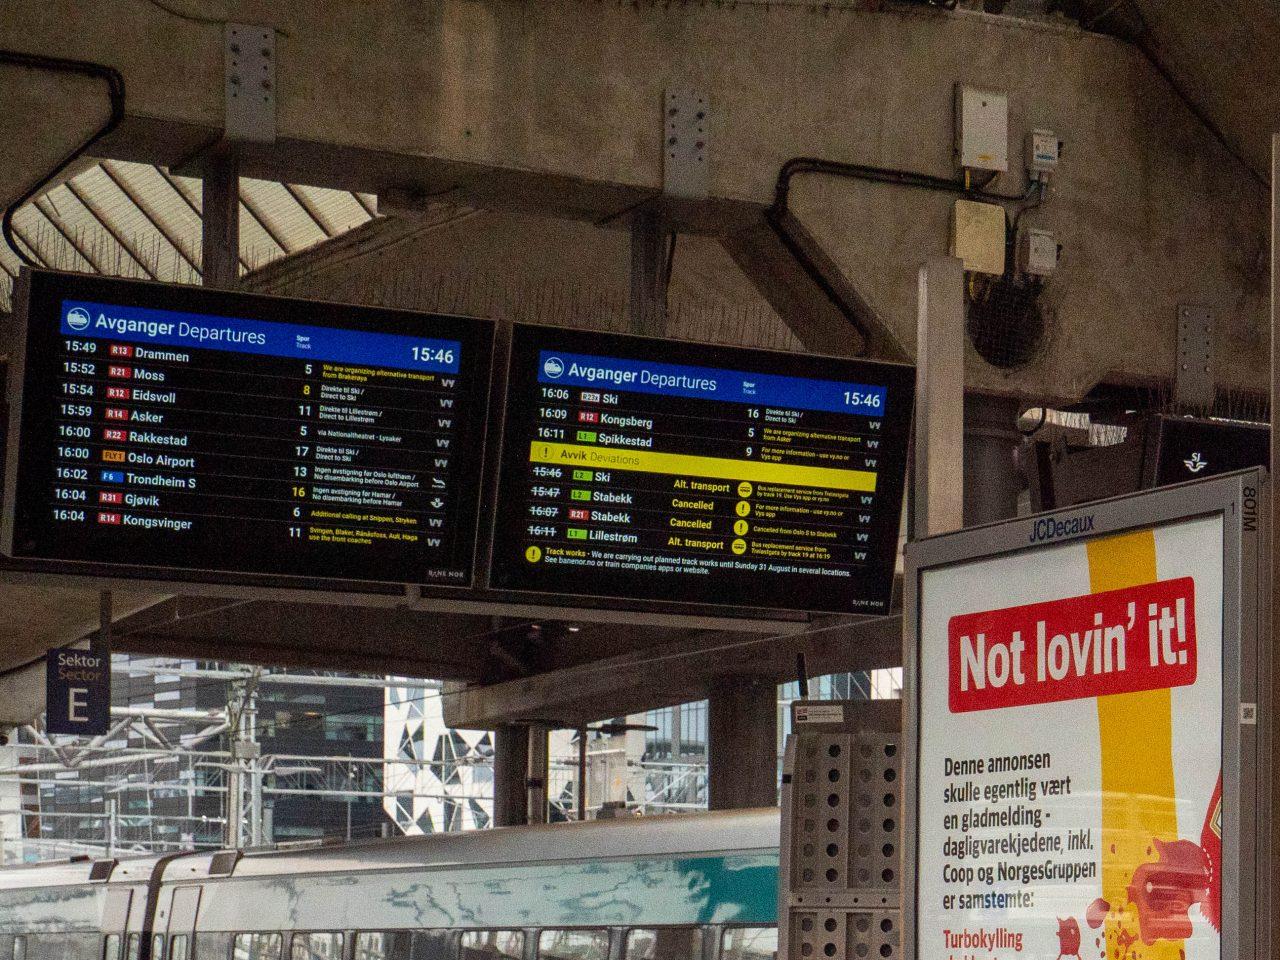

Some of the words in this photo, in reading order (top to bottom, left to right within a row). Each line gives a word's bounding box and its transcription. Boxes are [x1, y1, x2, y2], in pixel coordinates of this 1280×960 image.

[96, 314, 174, 337] Avganger
[179, 322, 266, 346] Departures
[65, 341, 96, 353] 15:49
[136, 348, 189, 362] Drammen
[305, 365, 313, 374] 5
[412, 347, 453, 363] 15:46
[64, 362, 95, 375] 15:52
[134, 369, 165, 381] Moss
[303, 385, 310, 395] 8
[568, 363, 638, 384] Avganger
[641, 370, 716, 391] Departures
[63, 384, 94, 396] 15:54
[133, 390, 176, 403] Eidsvoll
[299, 406, 311, 416] 11
[542, 388, 569, 399] 16:06
[603, 394, 618, 404] Ski
[748, 409, 759, 418] 16
[844, 392, 880, 407] 15:46
[61, 405, 92, 416] 15:59
[131, 411, 163, 423] Asker
[301, 426, 307, 436] 5
[540, 408, 567, 419] 16:09
[601, 414, 653, 429] Kongsberg
[749, 428, 754, 437] 5
[59, 426, 91, 437] 16:00
[130, 432, 188, 446] Rakkestad
[296, 447, 309, 456] 17
[538, 428, 564, 439] 16:11
[599, 434, 652, 447] Spikkestad
[746, 447, 752, 456] 9
[58, 447, 89, 459] 16:00
[128, 453, 153, 464] Oslo
[156, 455, 195, 468] Airport
[294, 467, 307, 476] 13
[561, 450, 586, 459] Avvik
[590, 452, 640, 465] Deviations
[57, 468, 88, 480] 16:02
[127, 473, 185, 488] Trondheim
[189, 479, 196, 488] S
[292, 488, 305, 497] 16
[595, 473, 610, 482] Ski
[674, 480, 688, 489] Alt.
[691, 483, 730, 492] transport
[55, 489, 86, 500] 16:04
[125, 495, 160, 506] Gjøvik
[294, 508, 300, 517] 6
[593, 492, 632, 503] Stabekk
[673, 500, 714, 510] Cancelled
[54, 510, 85, 522] 16:04
[124, 515, 193, 531] Kongsvinger
[289, 528, 301, 537] 11
[591, 511, 631, 523] Stabekk
[671, 519, 712, 529] Cancelled
[1029, 513, 1094, 542] JCDecaux
[590, 531, 638, 543] Lillestrøm
[669, 538, 682, 546] Alt.
[685, 539, 724, 549] transport
[960, 631, 1025, 692] Not
[1037, 601, 1136, 682] lovin'
[1149, 597, 1188, 667] it!
[58, 653, 100, 668] Sektor
[58, 667, 101, 681] Sector
[68, 688, 89, 722] E
[944, 757, 984, 777] Denne
[988, 753, 1050, 773] annonsen
[944, 782, 980, 803] skulle
[984, 778, 1036, 803] egentlig
[1041, 776, 1071, 796] vært
[943, 813, 958, 830] en
[962, 806, 1041, 831] gladmelding
[943, 835, 1064, 860] dagligvarekjedene,
[1068, 830, 1093, 850] inkl.
[943, 864, 974, 887] Coop
[978, 870, 994, 886] og
[998, 861, 1096, 885] NorgesGruppen
[943, 894, 956, 910] er
[959, 891, 1034, 910] samstemte:
[943, 928, 1023, 951] Turbokylling
